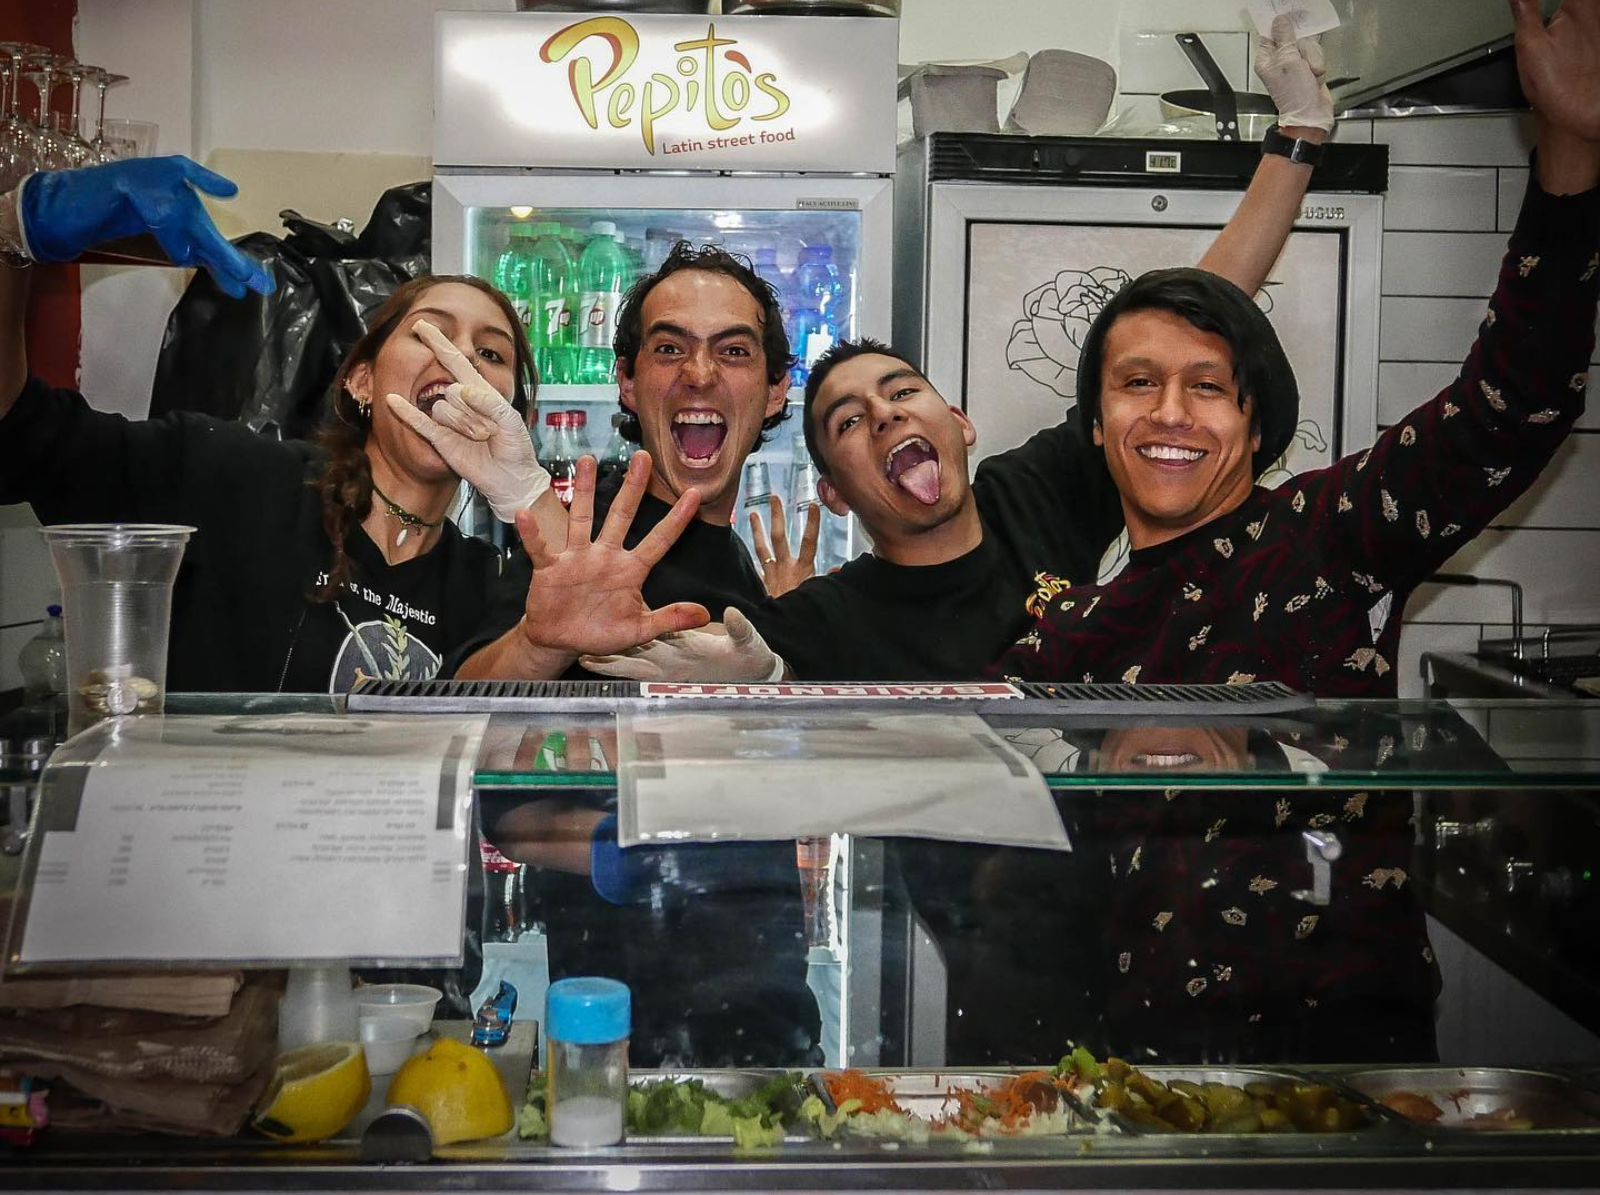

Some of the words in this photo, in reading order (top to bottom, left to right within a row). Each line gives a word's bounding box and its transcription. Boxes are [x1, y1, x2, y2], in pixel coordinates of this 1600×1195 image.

[663, 139, 703, 154] Latin
[708, 133, 755, 150] street
[760, 128, 796, 144] food
[363, 587, 382, 606] the
[385, 594, 436, 625] Majestic
